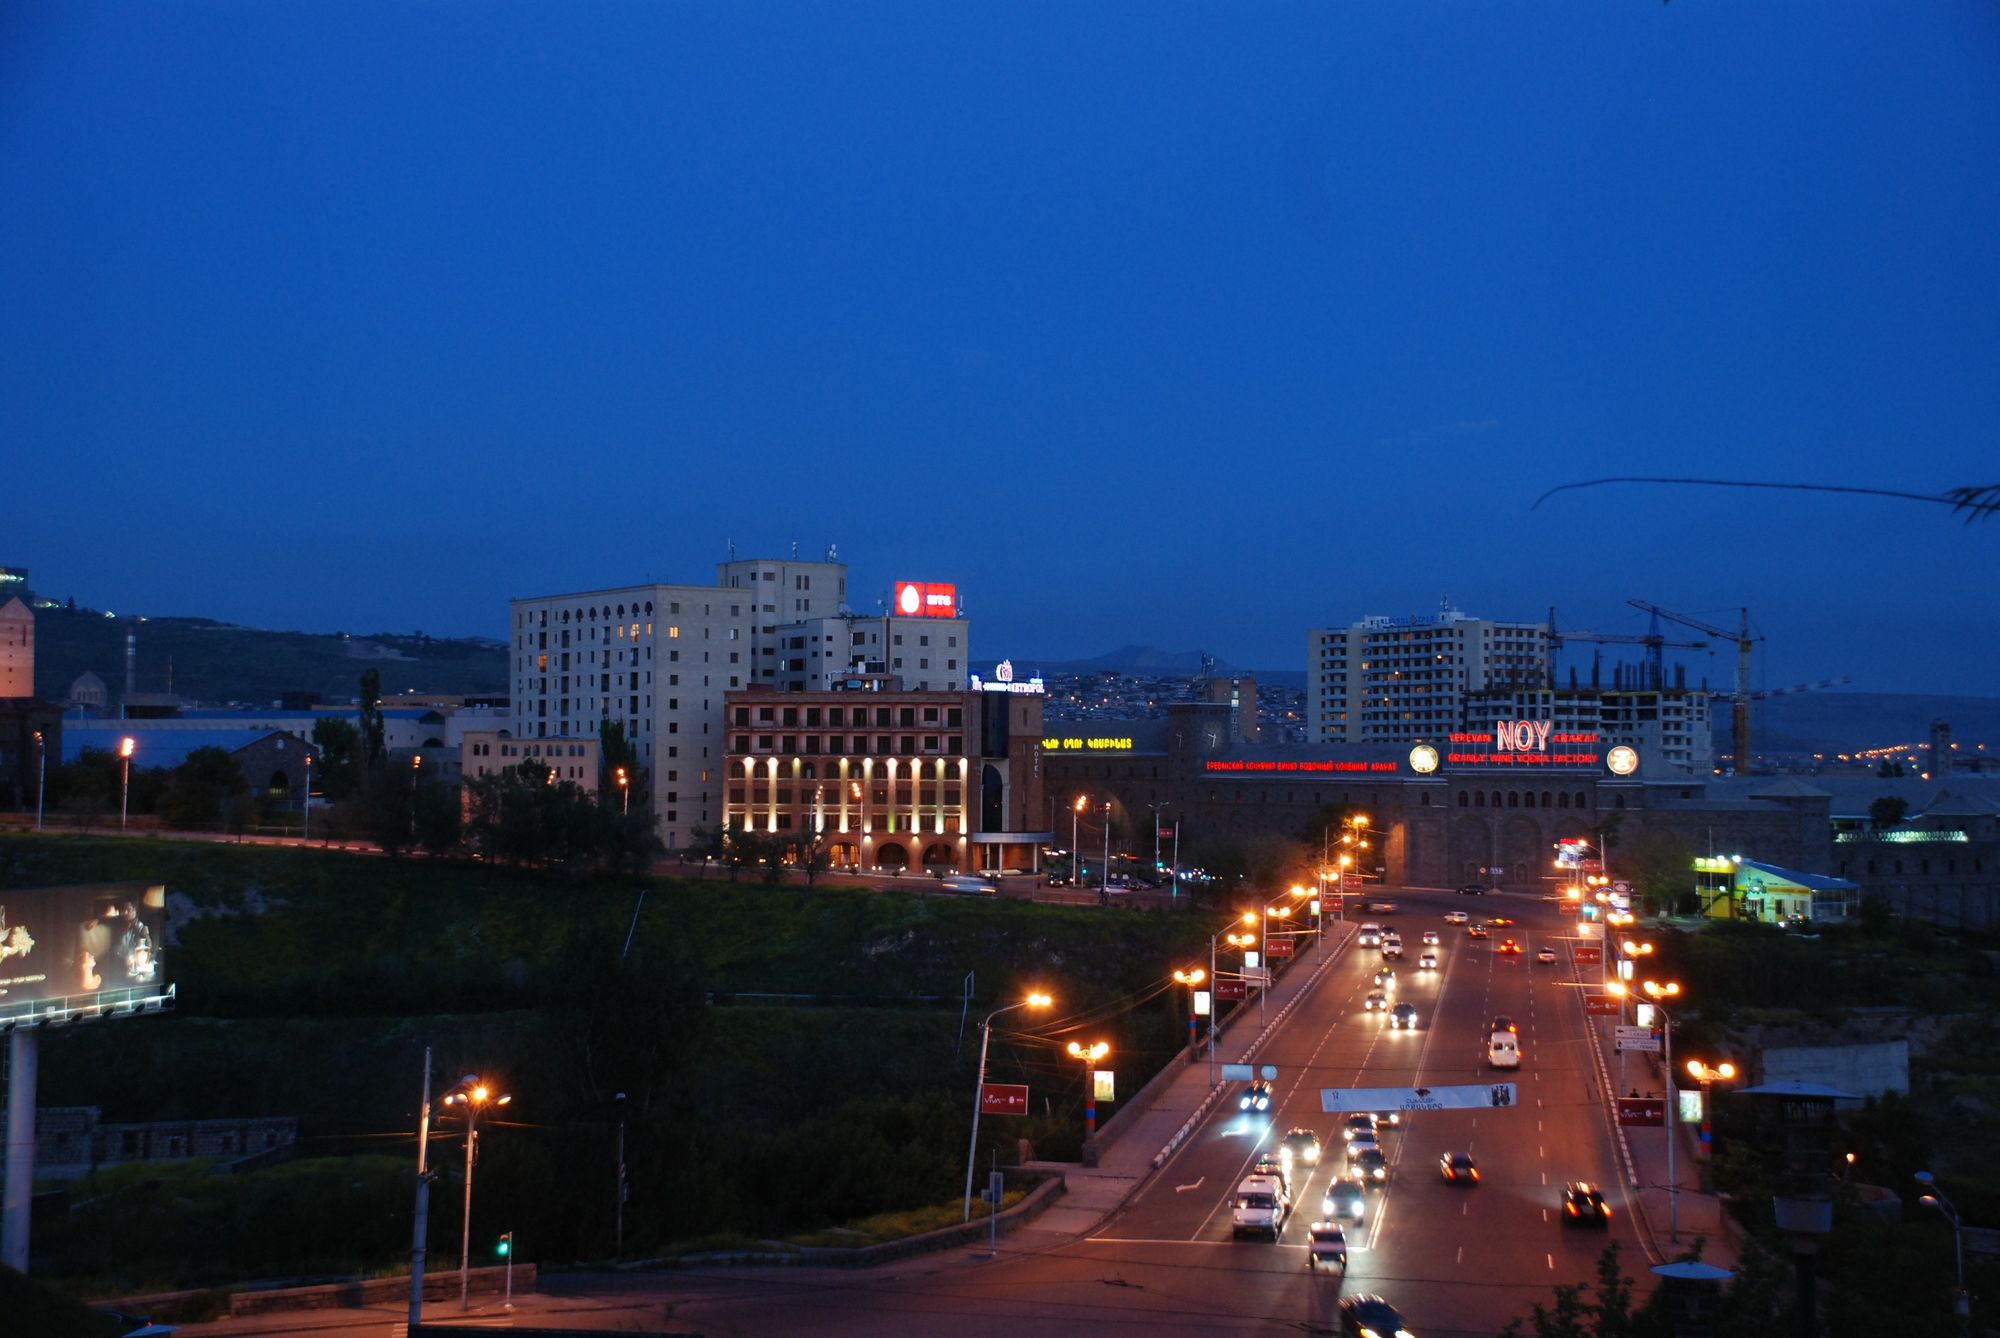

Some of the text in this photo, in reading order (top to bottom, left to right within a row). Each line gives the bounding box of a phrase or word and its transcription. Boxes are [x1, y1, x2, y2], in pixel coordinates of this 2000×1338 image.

[1448, 733, 1492, 742] YEREVAN
[1497, 720, 1551, 751] NOY
[1552, 733, 1599, 743] ARARAT
[1490, 754, 1512, 763] WINE
[1553, 754, 1598, 763] FACTORY
[1371, 762, 1397, 771] АРАРАТ
